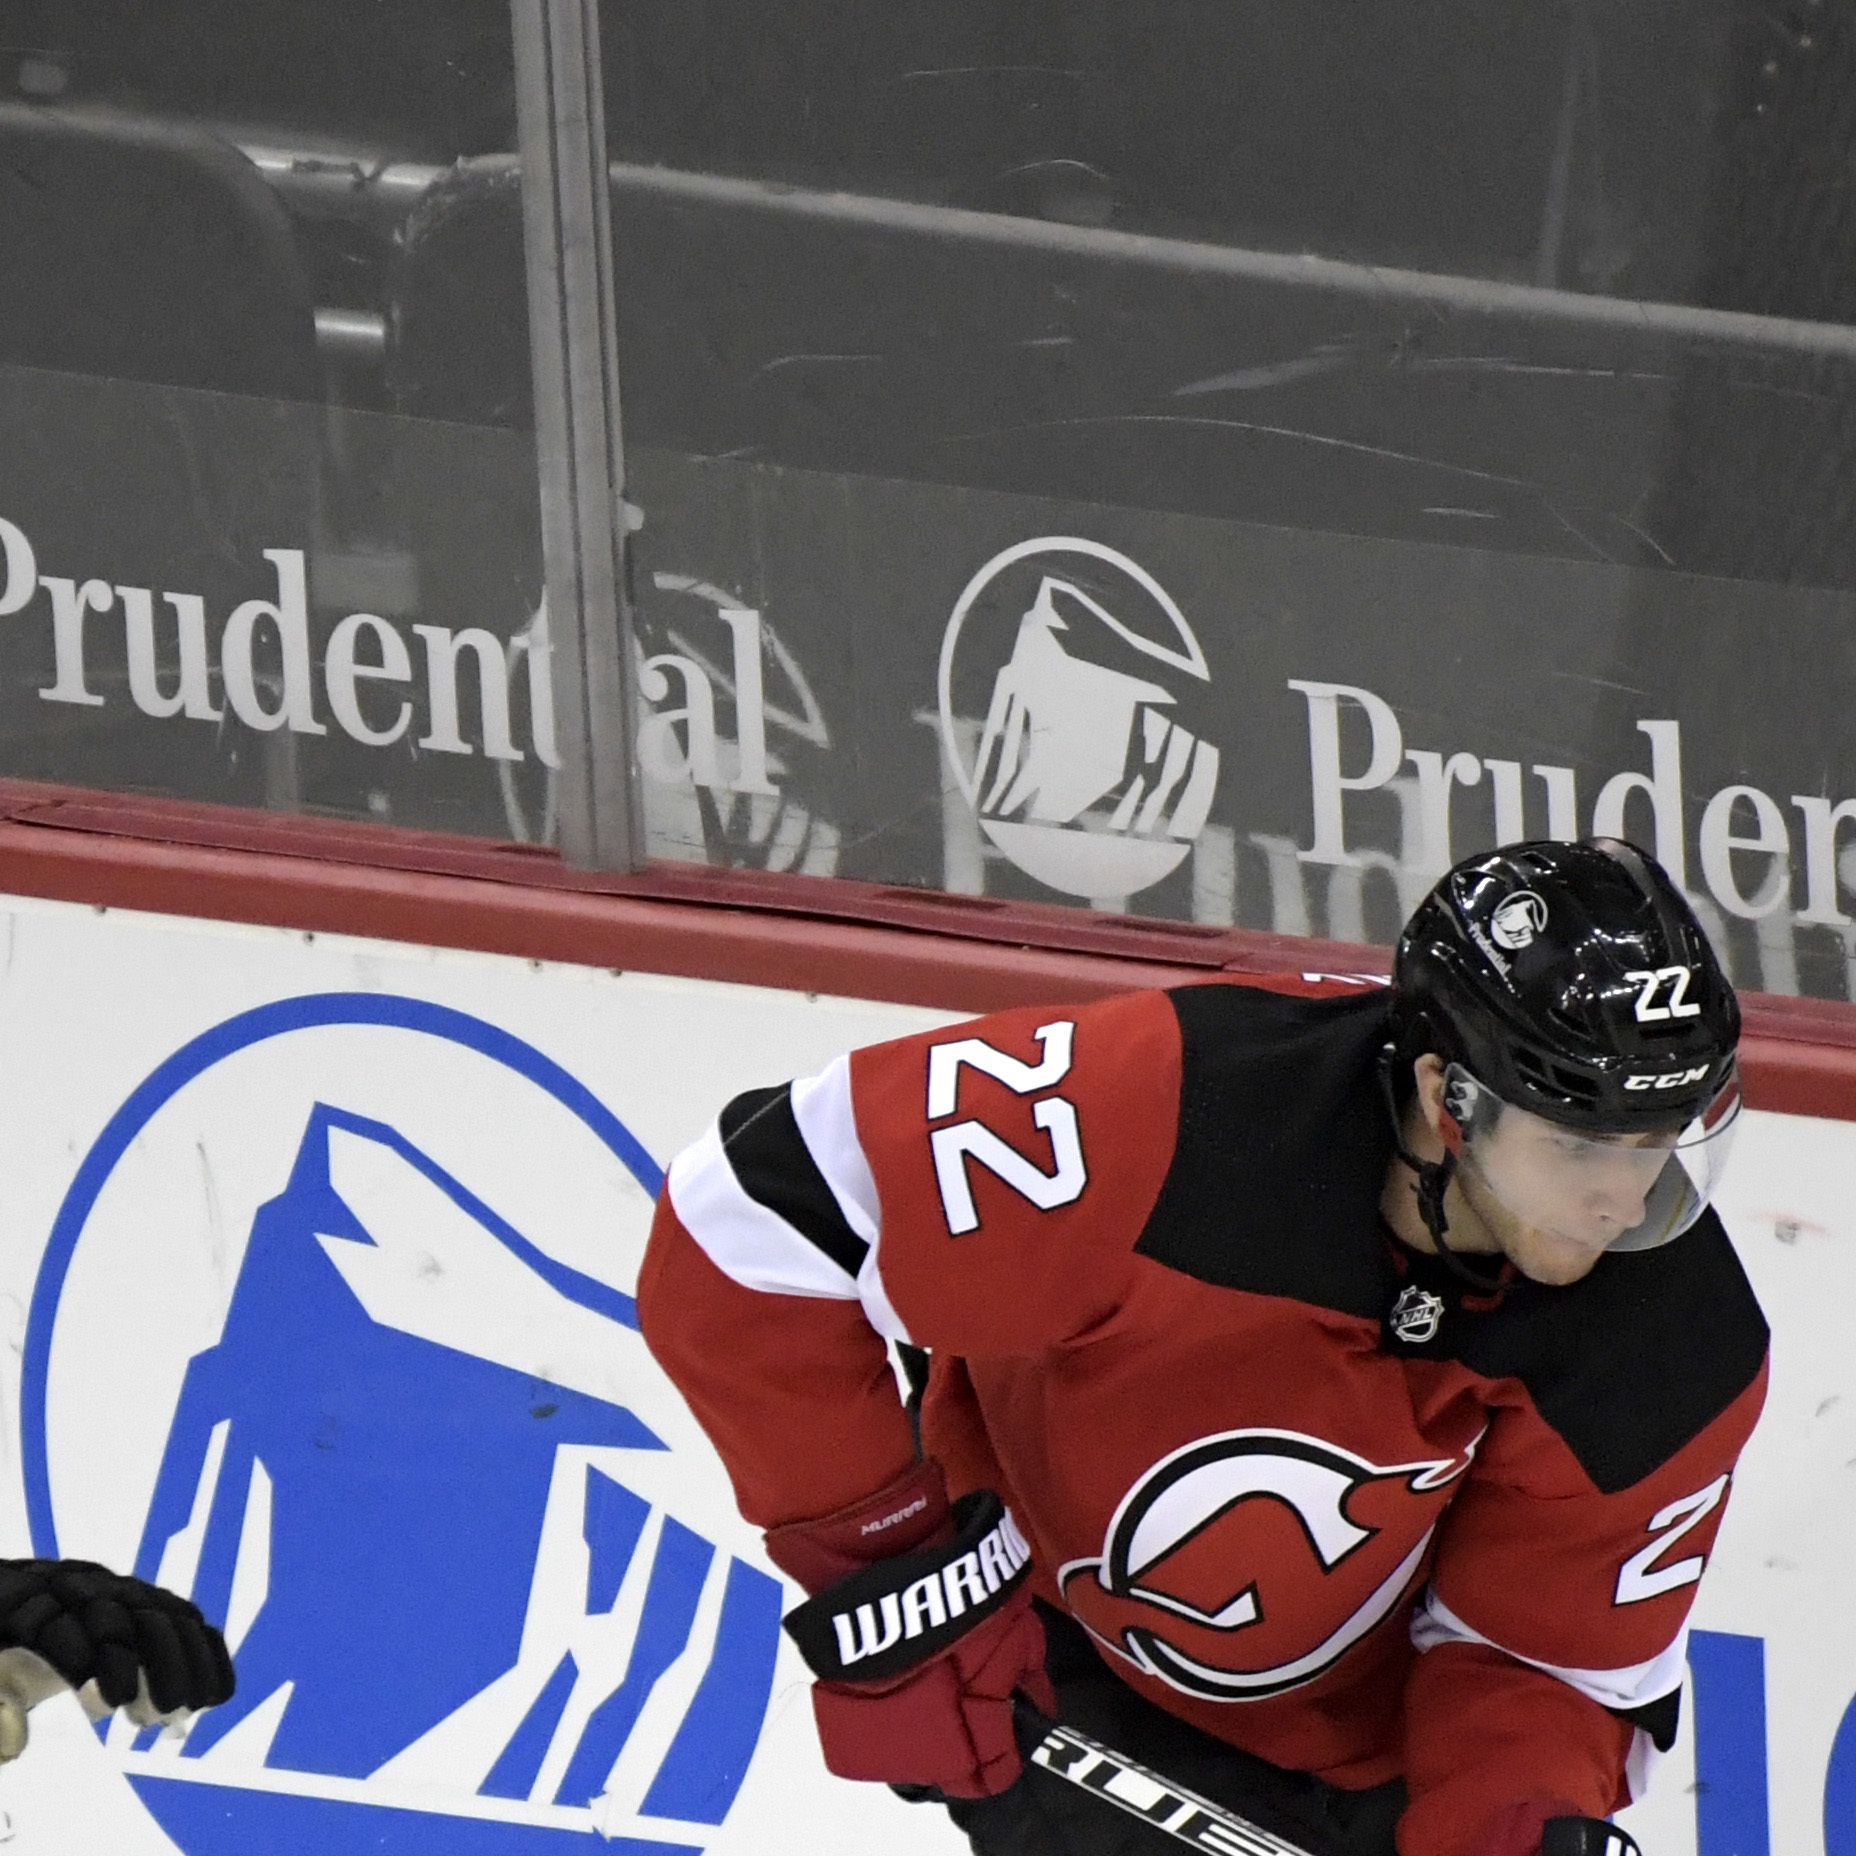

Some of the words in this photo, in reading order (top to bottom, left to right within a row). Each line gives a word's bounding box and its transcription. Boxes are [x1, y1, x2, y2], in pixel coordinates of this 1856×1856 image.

[1623, 965, 1702, 1023] 22
[1623, 1063, 1711, 1091] CCM
[924, 1018, 1088, 1237] 22
